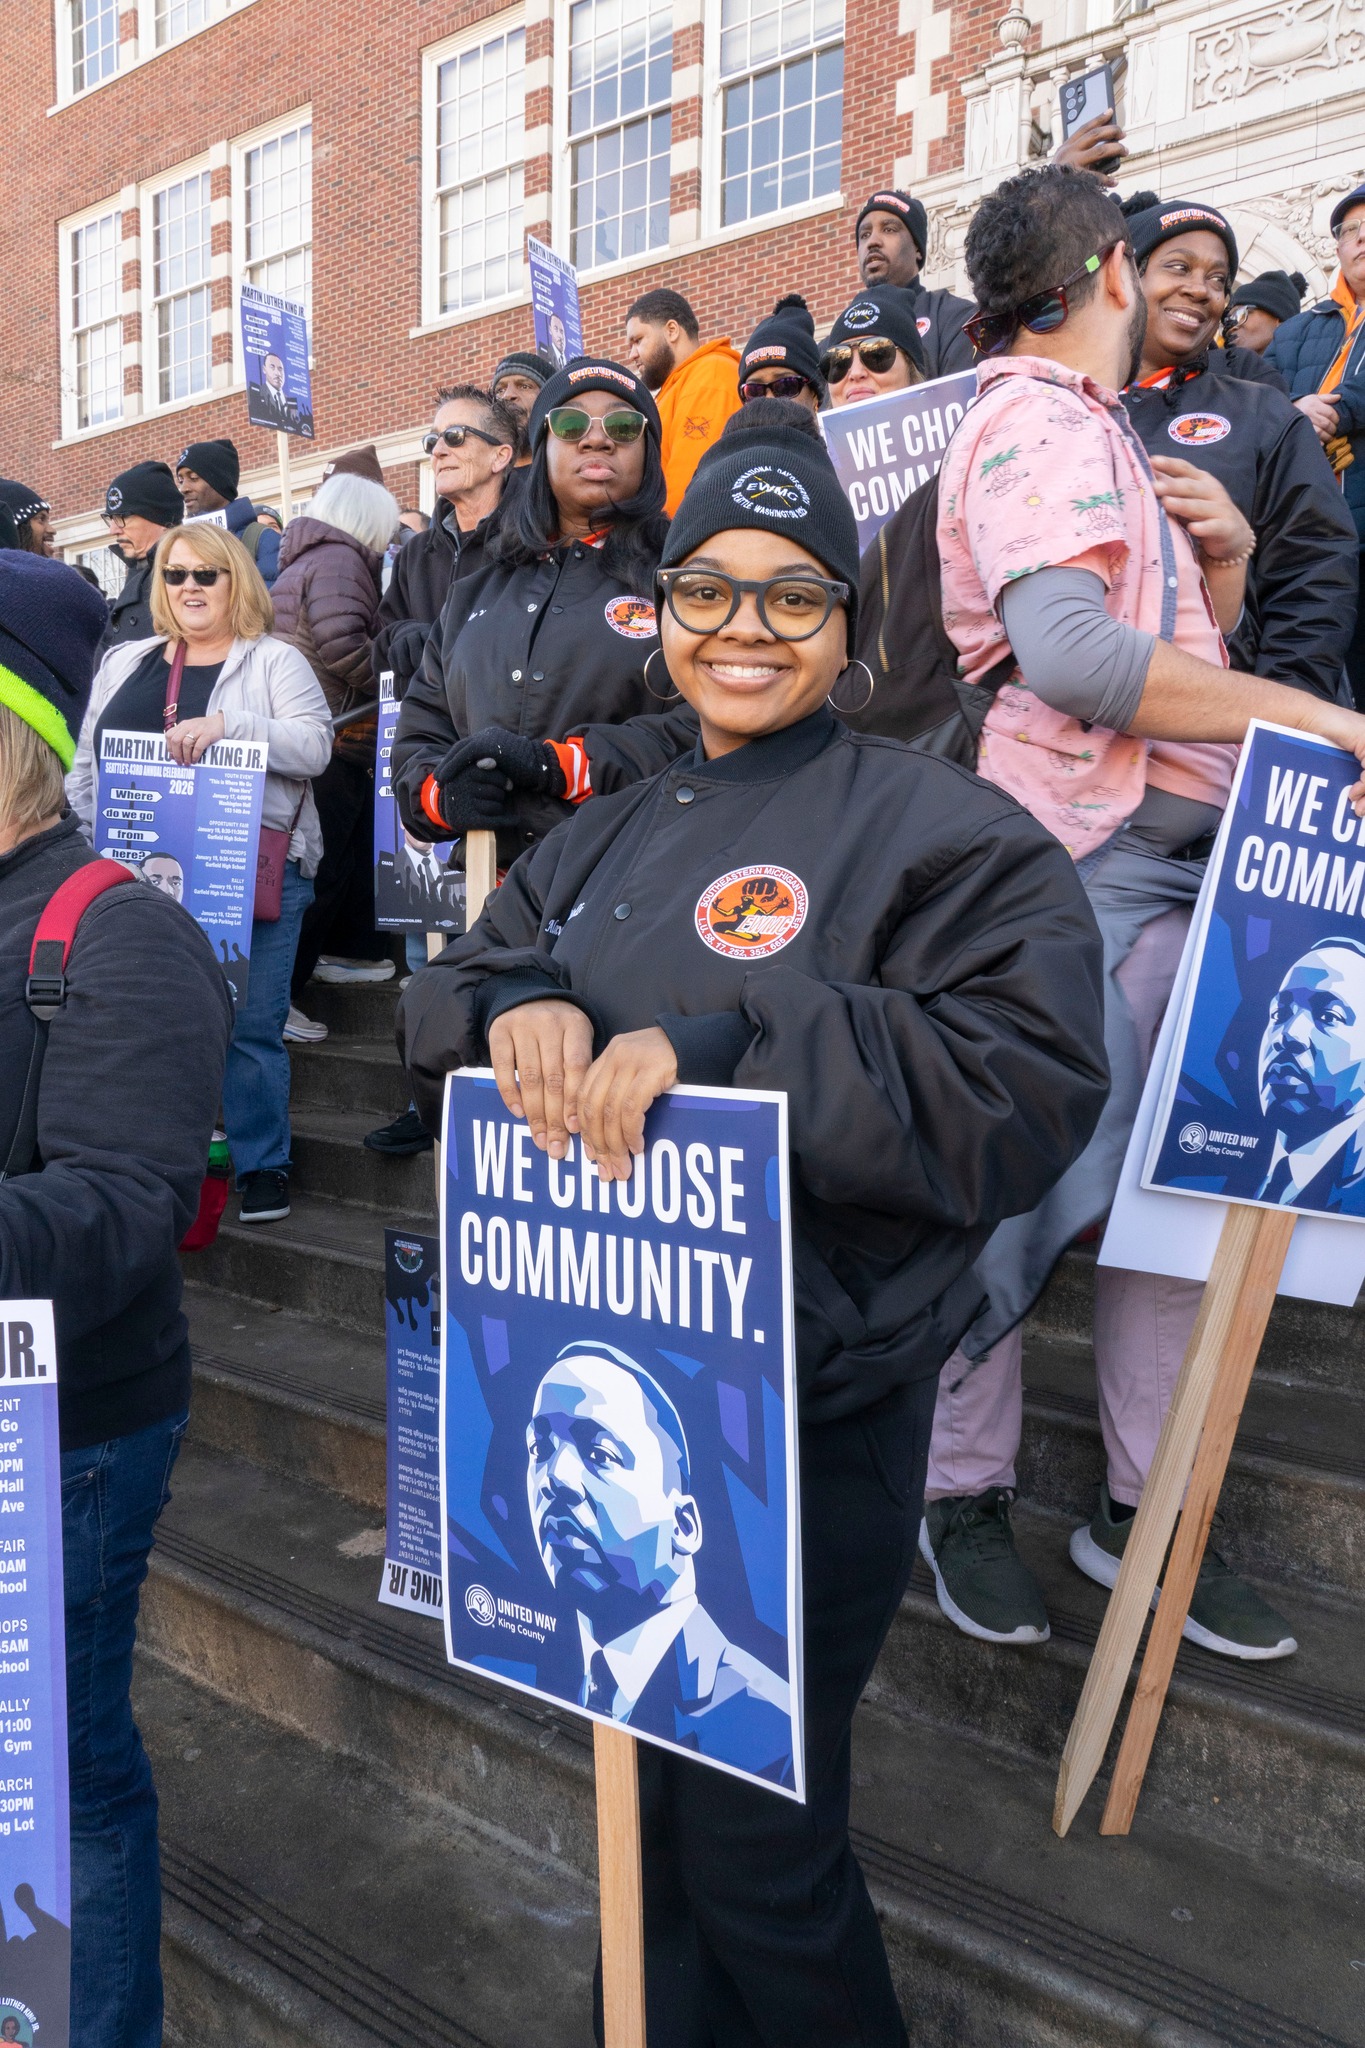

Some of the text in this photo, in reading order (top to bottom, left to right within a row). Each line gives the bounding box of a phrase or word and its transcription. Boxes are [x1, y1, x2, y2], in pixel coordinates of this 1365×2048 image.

[242, 285, 262, 303] MARTIN
[264, 293, 284, 310] LUTHER
[285, 300, 298, 316] KING
[568, 367, 599, 381] WHAT
[846, 396, 977, 472] WE CHO
[746, 482, 798, 502] EWMC
[104, 736, 264, 769] MARTIN KING JR.
[105, 762, 129, 774] SEATTLE'S
[144, 764, 162, 778] ANNUAL
[163, 766, 196, 780] CELEBRATION
[116, 790, 153, 800] Where
[169, 780, 194, 796] 2026
[1264, 765, 1329, 836] WE
[106, 809, 120, 818] do
[140, 812, 152, 820] go
[118, 830, 144, 840] from
[112, 849, 146, 860] here?
[1235, 835, 1365, 918] COMM
[700, 866, 806, 929] SOUTHEASTERN MICHIGAN CHAPTER
[734, 915, 794, 935] EWMC
[1208, 1130, 1259, 1149] UNITED WAY
[1205, 1144, 1245, 1158] King County
[472, 1119, 533, 1203] WE
[460, 1211, 765, 1344] COMMUNITY.
[405, 1349, 422, 1362] Parking
[422, 1354, 432, 1364] High
[398, 1368, 413, 1378] MARCH
[424, 1364, 440, 1376] anuary
[398, 1387, 434, 1404] High School Gym
[398, 1406, 412, 1416] RALLY
[418, 1401, 436, 1414] January
[1, 1419, 18, 1432] Go
[398, 1425, 423, 1439] High School
[399, 1444, 426, 1460] WORKSHOPS
[399, 1464, 423, 1478] High School
[0, 1478, 24, 1493] Hall
[399, 1483, 408, 1492] FAIR
[1, 1500, 25, 1513] Ave
[399, 1511, 434, 1529] Washington Hall
[412, 1534, 423, 1544] From
[400, 1540, 429, 1557] Where We Go
[398, 1550, 430, 1566] YOUTH EVENT
[0, 1578, 27, 1594] hool
[388, 1562, 408, 1596] JR.
[498, 1598, 556, 1632] UNITED WAY
[498, 1617, 545, 1644] King County
[0, 1698, 30, 1713] ALLY
[4, 1739, 32, 1755] Gym
[0, 1777, 32, 1792] ARCH
[14, 1817, 34, 1831] Lot
[2, 1997, 40, 2033] LUTHER KING JR.
